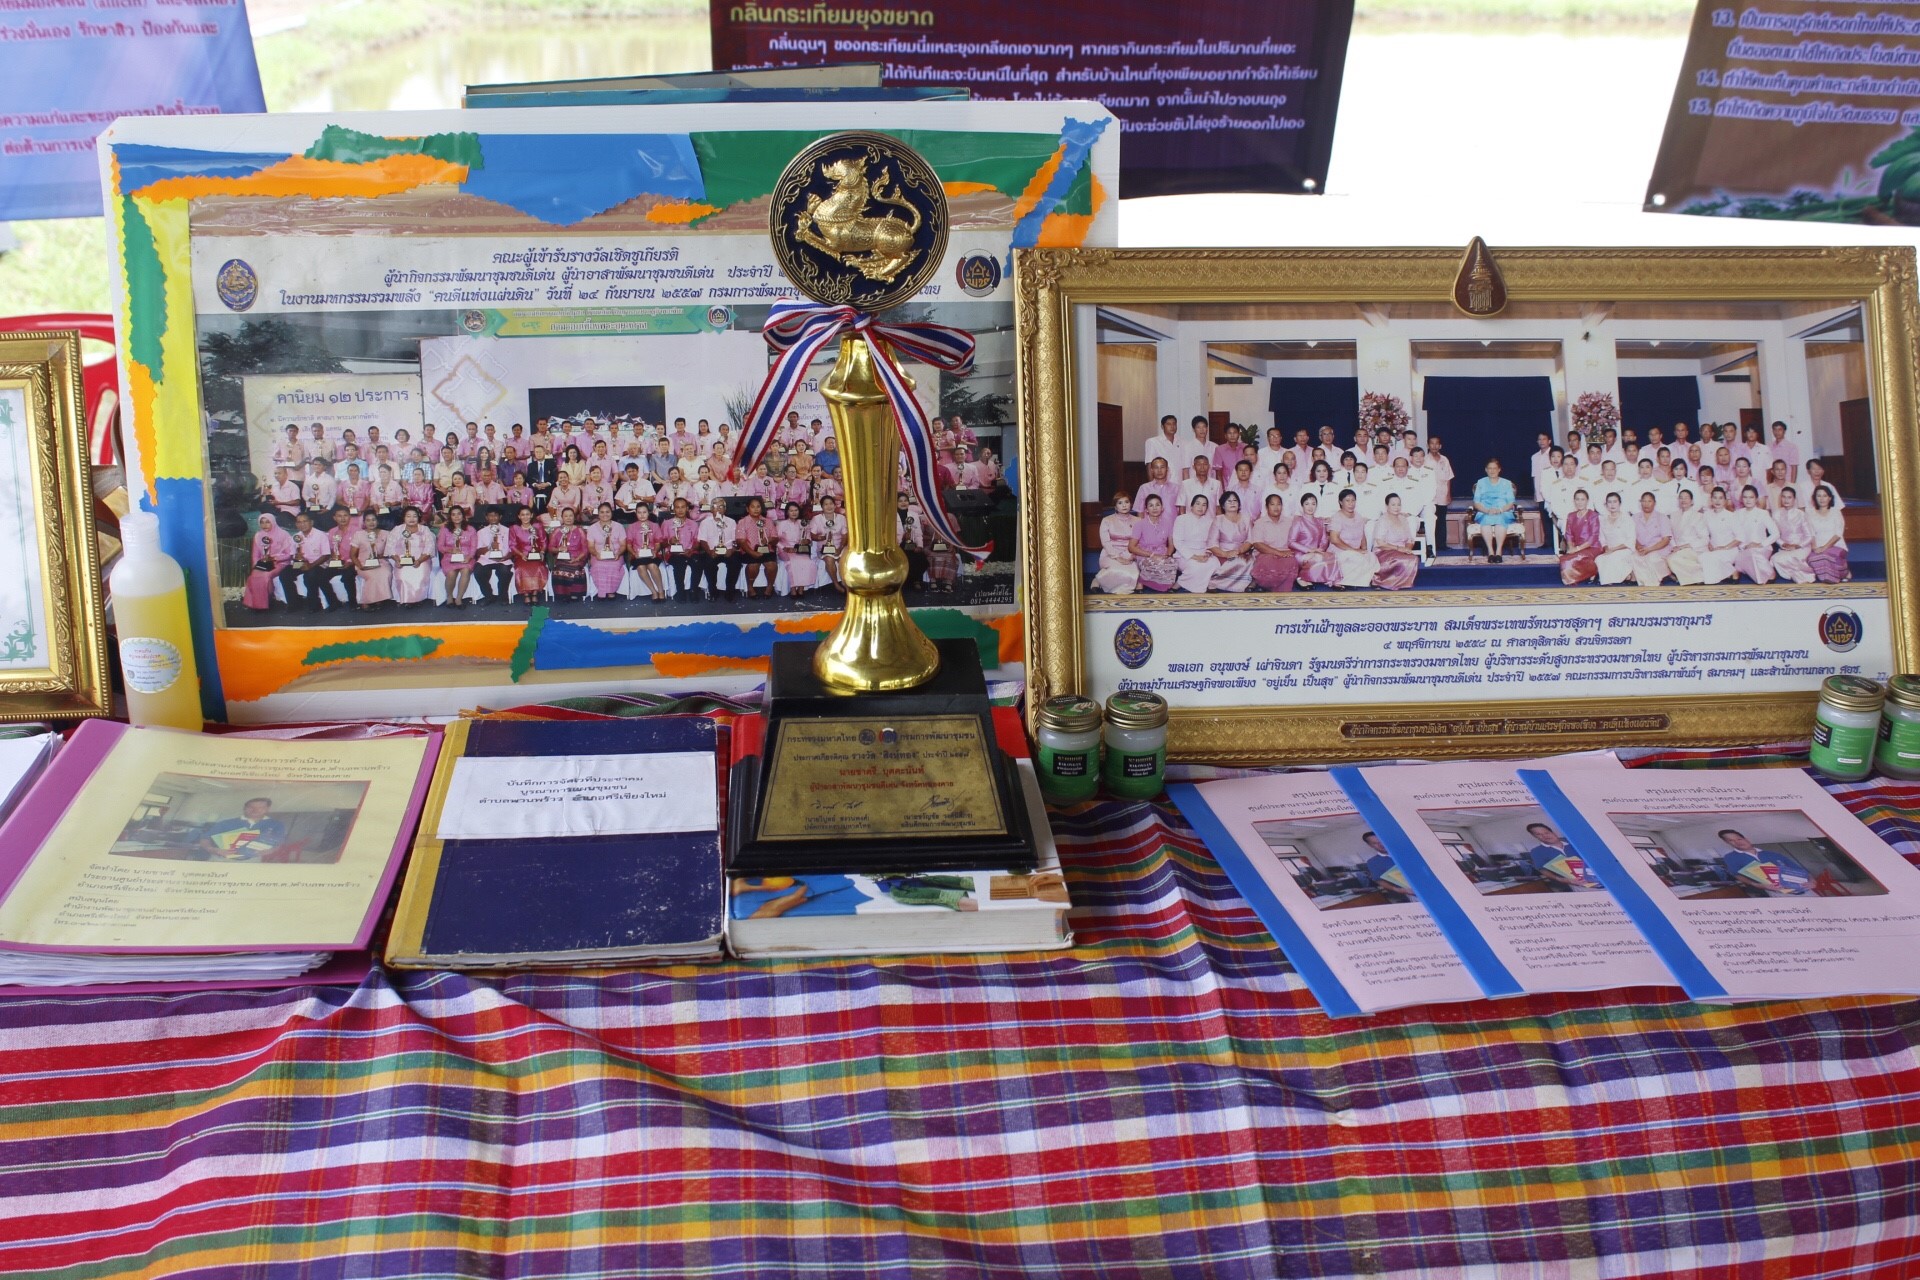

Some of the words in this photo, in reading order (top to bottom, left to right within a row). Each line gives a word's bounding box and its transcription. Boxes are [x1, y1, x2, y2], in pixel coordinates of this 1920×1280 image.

[730, 0, 935, 30] กลิ่นกระเทียมยุงขยาด
[1712, 8, 1736, 28] 13.
[77, 19, 136, 37] รักษาสิว
[769, 31, 827, 53] กลิ่นฉุนๆ
[834, 34, 1074, 60] ของกระเทียมนี่แหละยุงเกลียดเอามากๆ
[1696, 69, 1720, 87] 14.
[1688, 97, 1712, 115] 15.
[492, 247, 680, 267] คณะผู้เข้ารับรางวัลเชิดชูเกียรติ
[384, 266, 555, 288] ผู้นำกิจกรรมพัฒนาชุมชนดีเด่น
[562, 265, 715, 287] ผู้นำอาสาพัฒนาชุมชนดีเด่น
[728, 262, 773, 279] ประจำปี
[280, 288, 421, 306] ในงานมหกรรมรวมพลัง
[546, 283, 572, 301] วันที่
[578, 288, 598, 300] ๒๔
[605, 284, 655, 300] กันยายน
[329, 392, 351, 404] ๑๒
[355, 387, 409, 403] ประการ
[1275, 618, 1437, 638] การเข้าเฝ้าทูลละอองพระบาท
[1443, 614, 1602, 632] สมเด็จพระเทพรัตนราชสุดาฯ
[1608, 613, 1712, 631] สยามบรมราชกุมารี
[1397, 637, 1450, 652] พฤศจิกายน
[1490, 638, 1502, 649] ณ
[1575, 634, 1632, 647] สวนจิตรลดา
[1168, 661, 1204, 674] พลเอก
[1210, 657, 1252, 676] อนุพงษ์
[1256, 657, 1303, 672] เผ่าจินดา
[1309, 653, 1478, 673] รัฐมนตรีว่าการกระทรวงมหาดไทย
[1484, 649, 1661, 670] ผู้บริหารระดับสูงกระทรวงมหาดไทย
[1667, 648, 1809, 667] ผู้บริหารกรมการพัฒนาชุมชน
[1343, 671, 1482, 689] ผู้นำกิจกรรมพัฒนาชุมชนดีเด่น
[1487, 670, 1525, 684] ประจำปี
[1565, 666, 1702, 682] คณะกรรมการบริหารสมาพันธ์ฯ
[1707, 667, 1745, 681] สมาคมฯ
[1750, 664, 1836, 678] และสำนักงานกลาง
